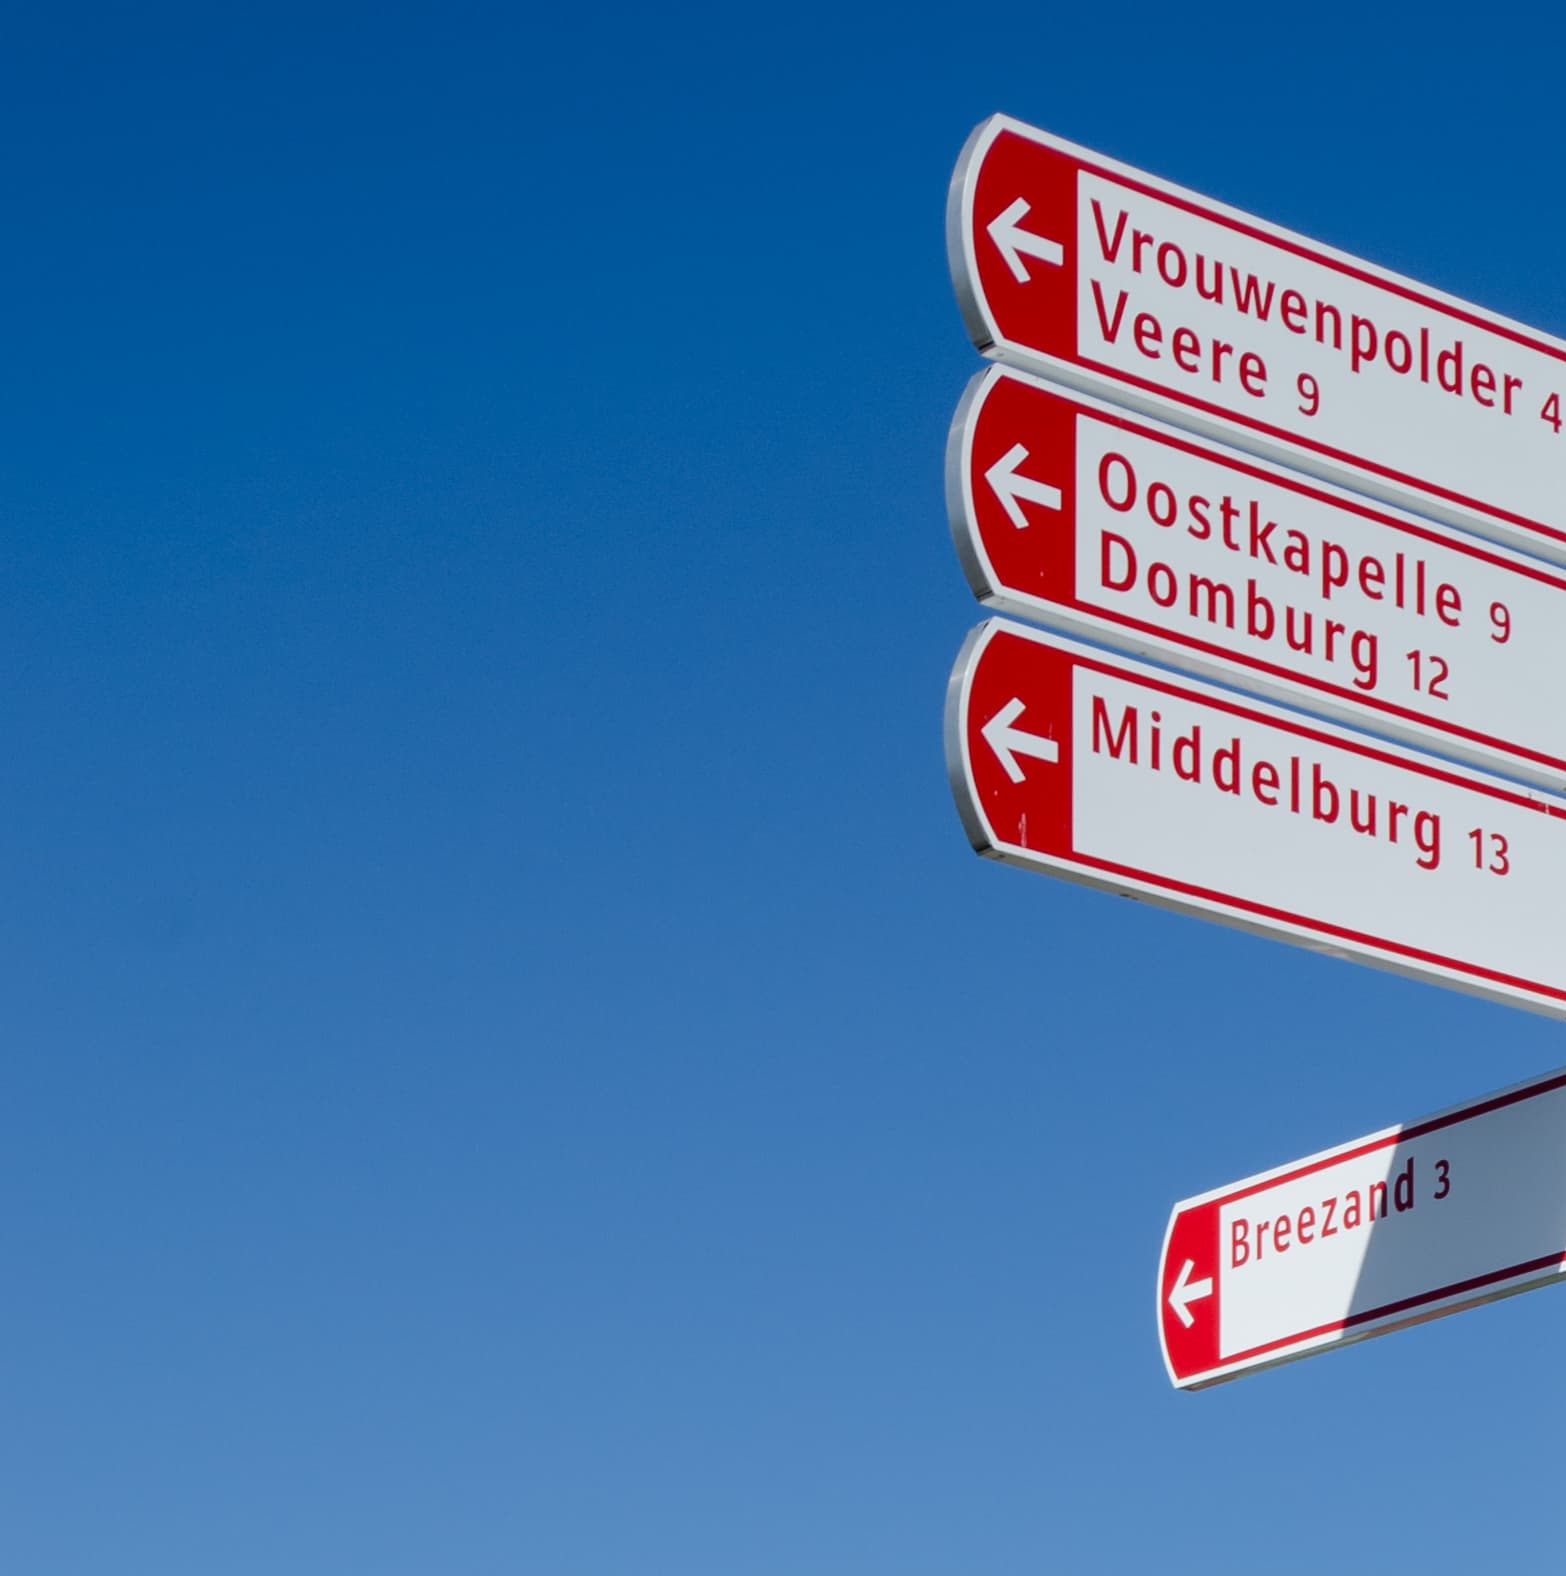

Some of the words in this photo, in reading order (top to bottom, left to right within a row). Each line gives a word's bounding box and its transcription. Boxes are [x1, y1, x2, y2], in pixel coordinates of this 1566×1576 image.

[1090, 199, 1523, 416] Vrouwenpolder
[1540, 392, 1562, 433] 4
[1090, 279, 1268, 398] Veere
[1296, 372, 1320, 417] 9
[1097, 451, 1462, 628] Oostkapelle
[1489, 601, 1512, 644] 9
[1100, 529, 1378, 691] Domburg
[1407, 649, 1449, 700] 12
[1091, 695, 1441, 871] Middelburg
[1468, 827, 1510, 876] 13
[1231, 1156, 1414, 1269] Breezand
[1433, 1159, 1450, 1200] 3
